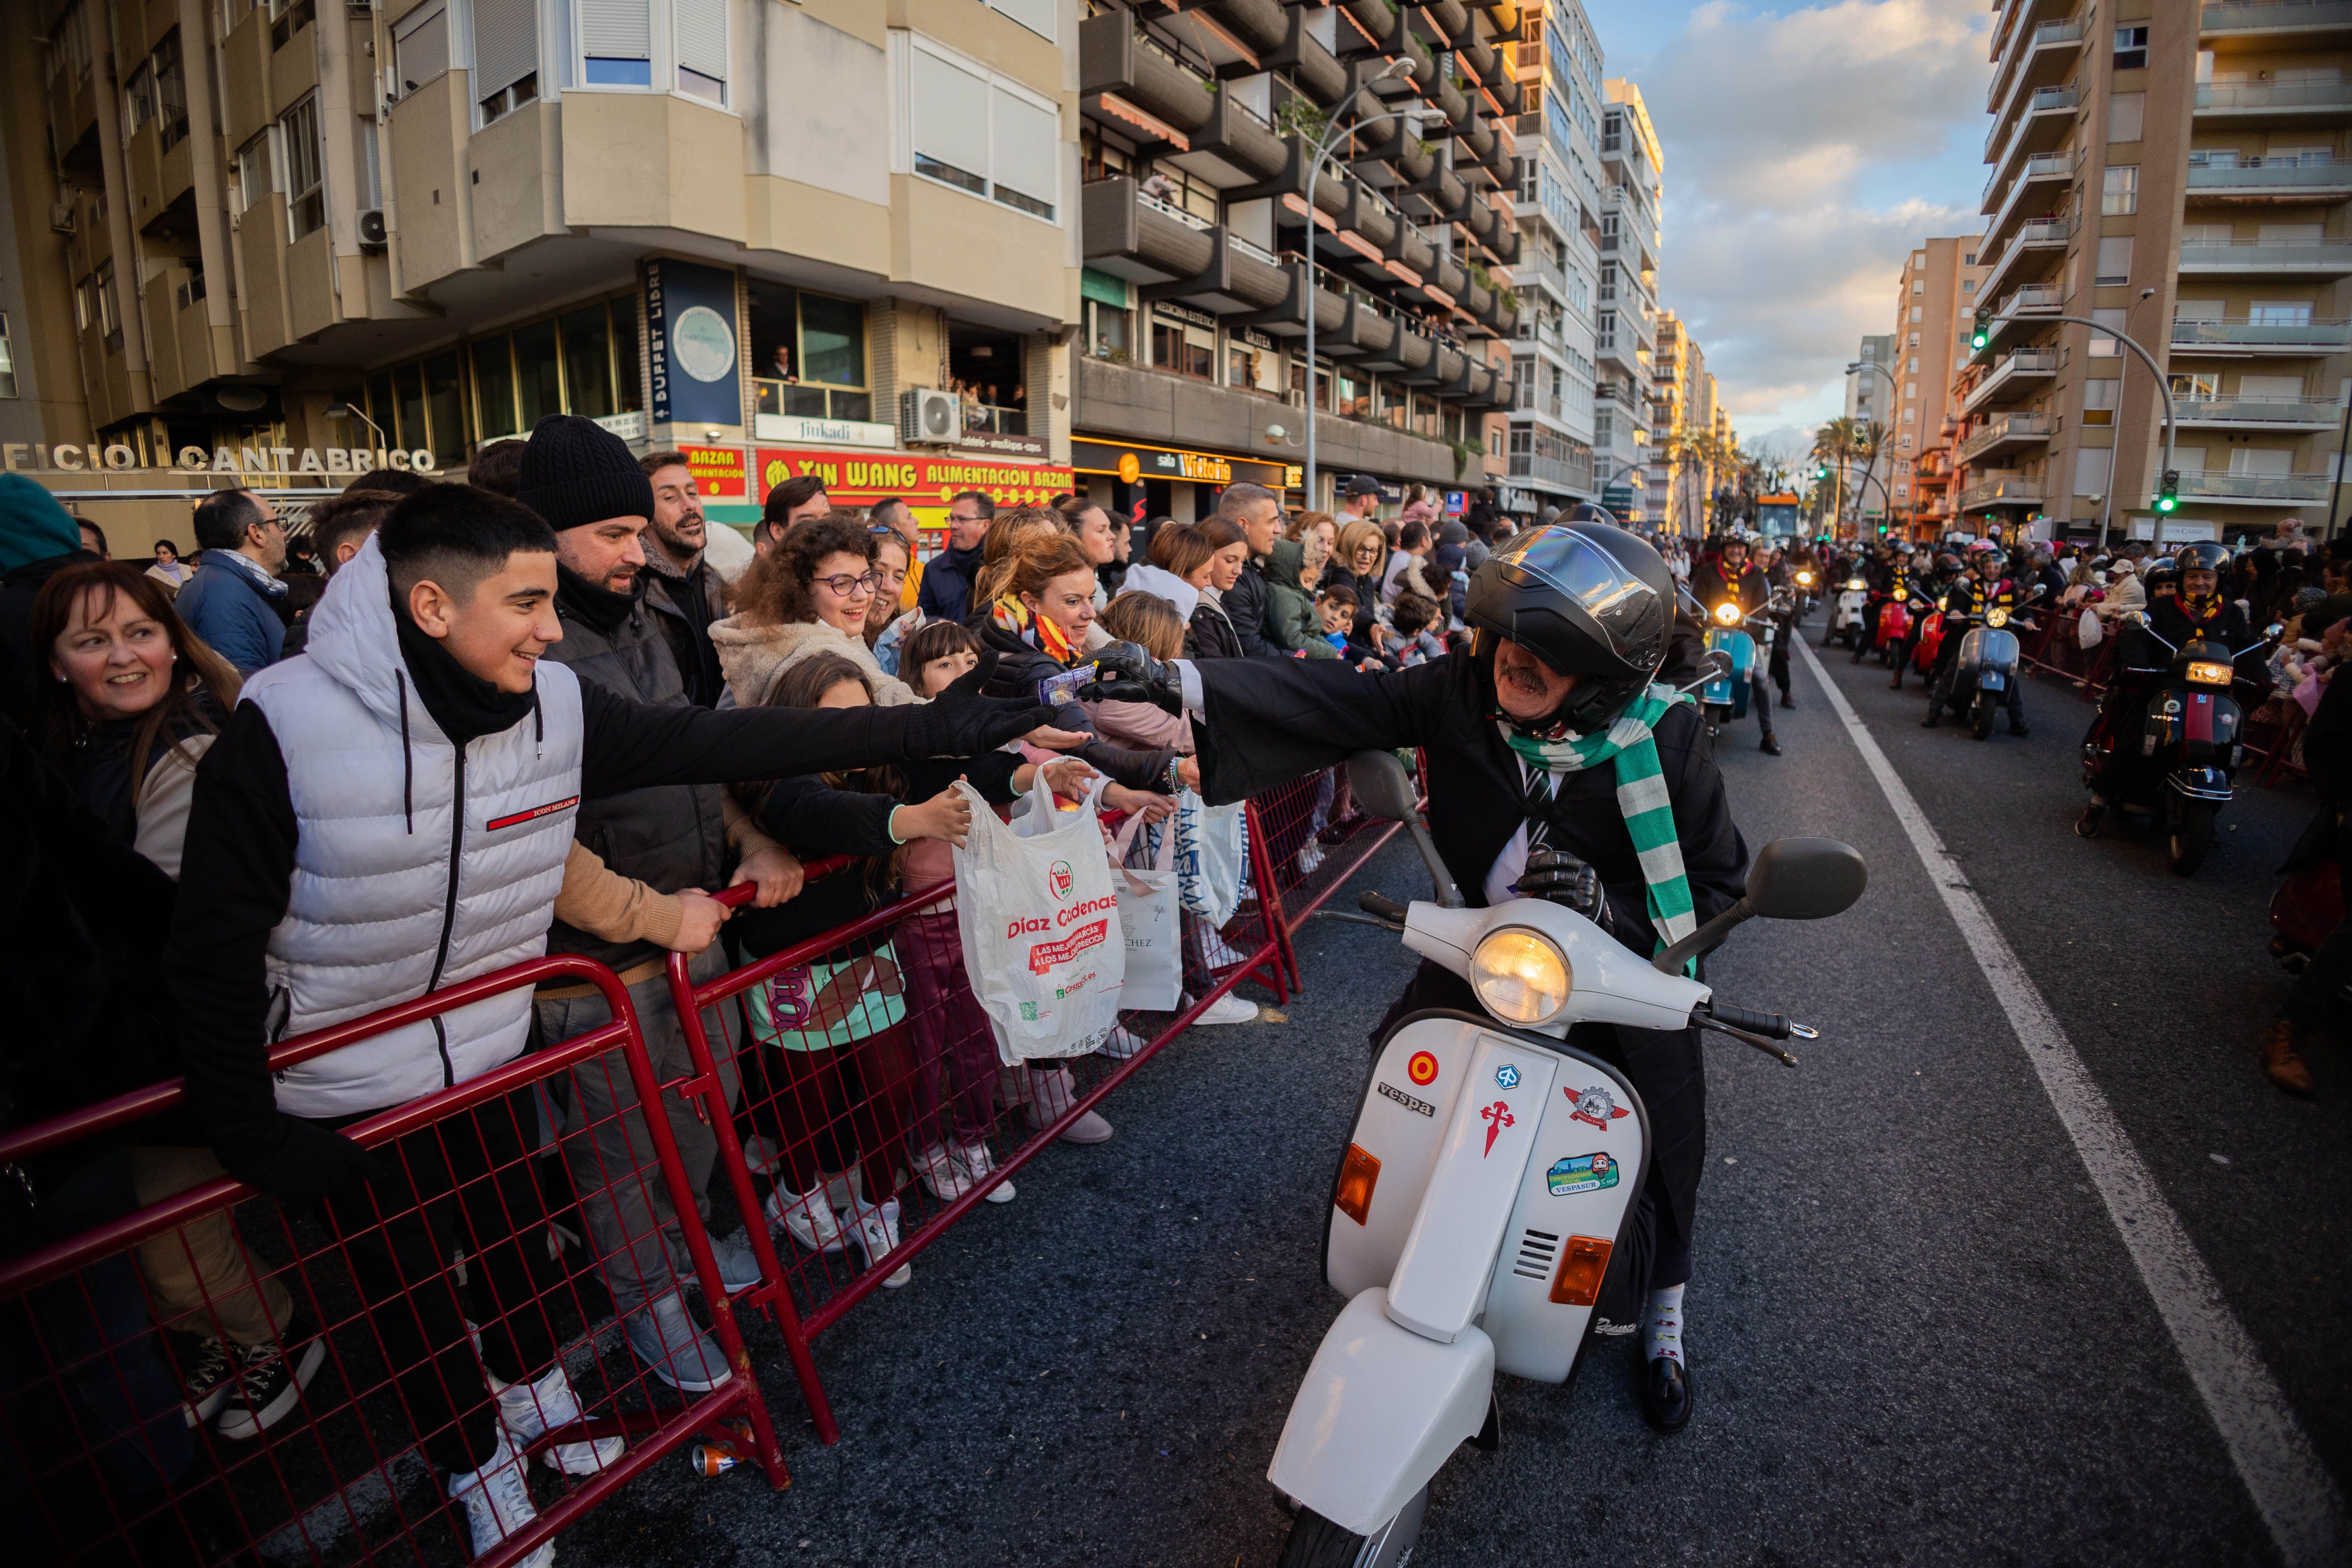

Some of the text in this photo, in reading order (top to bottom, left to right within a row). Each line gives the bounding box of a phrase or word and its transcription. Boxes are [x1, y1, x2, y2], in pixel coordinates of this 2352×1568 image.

[1155, 300, 1188, 319] MEDICINA
[648, 263, 667, 402] BUFFET LIBRE
[179, 446, 435, 473] CANTABRICO
[691, 450, 735, 466] BAZAR
[1157, 453, 1231, 481] sala Victoria
[845, 461, 918, 488] WANG
[927, 464, 1030, 487] ALIMENTACIÓN
[1034, 471, 1073, 489] BAZAR
[533, 799, 576, 817] ICON MILANO
[1008, 894, 1118, 939] Díaz Cadenas
[1035, 958, 1041, 967] A
[1041, 955, 1057, 965] LOS
[1078, 933, 1104, 949] PRECIOS
[1035, 946, 1052, 956] LAS
[1380, 1083, 1431, 1115] vespa
[1550, 1172, 1592, 1182] CONCESIONARIO
[1556, 1182, 1596, 1193] VESPASUR
